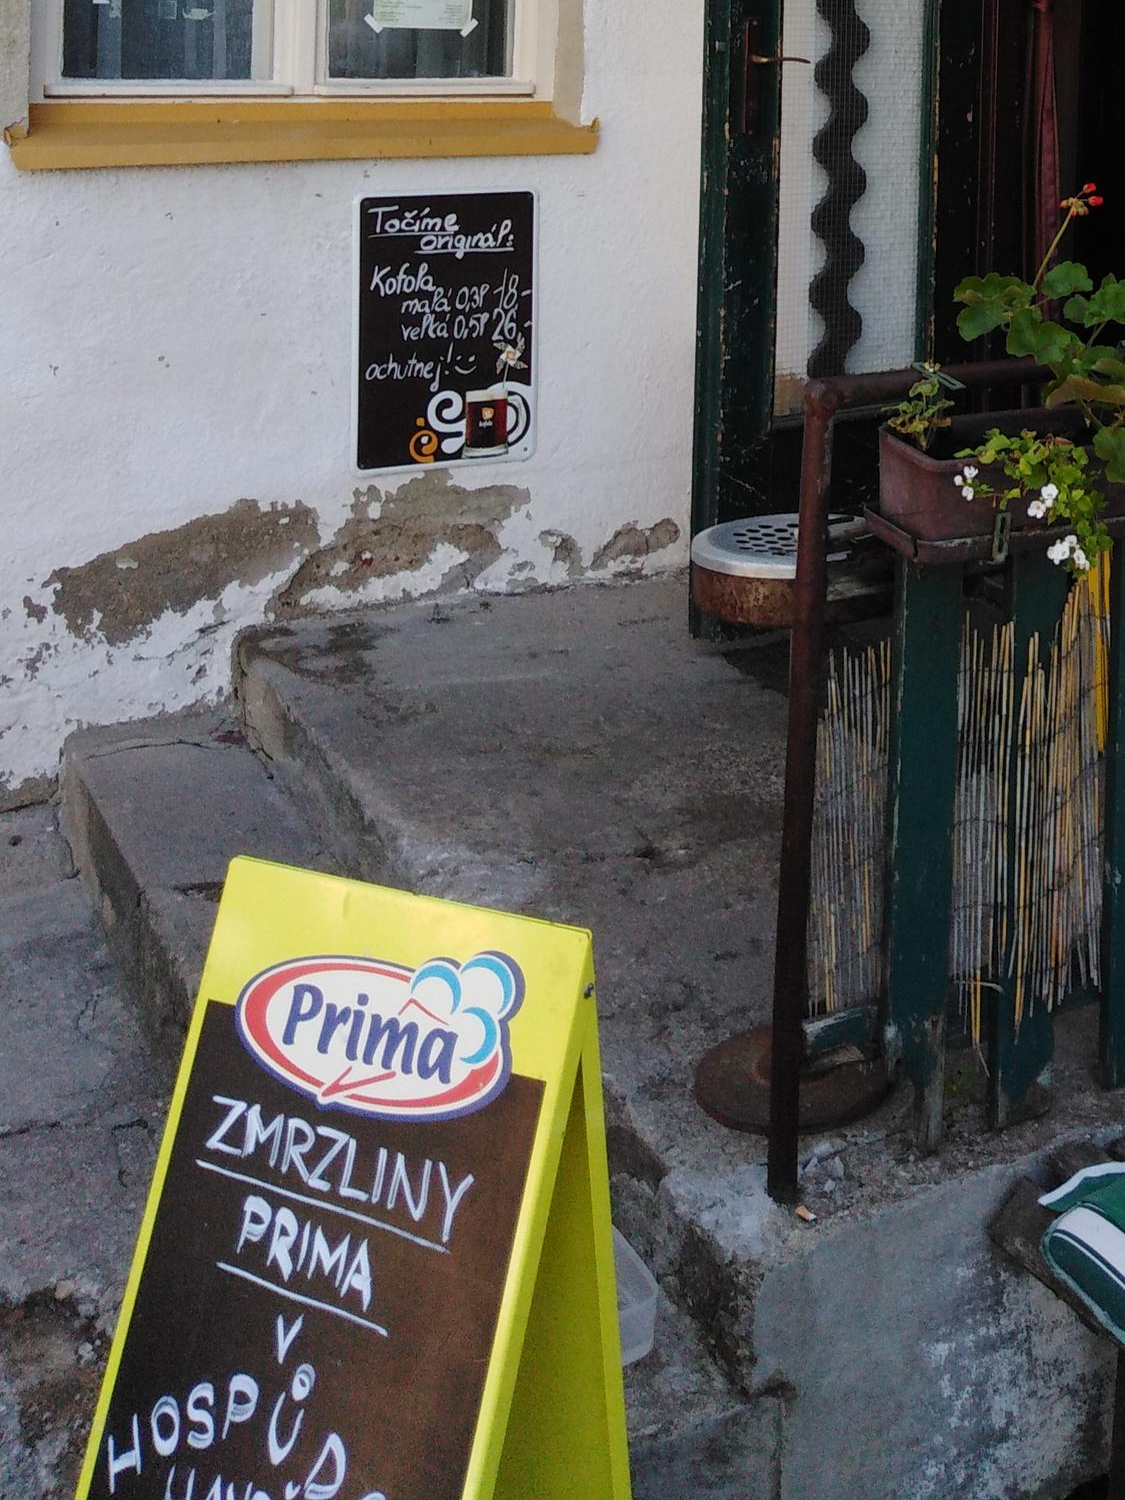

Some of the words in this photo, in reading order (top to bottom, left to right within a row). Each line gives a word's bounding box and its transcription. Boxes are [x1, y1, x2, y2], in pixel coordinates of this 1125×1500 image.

[368, 205, 460, 233] Točíme
[370, 262, 437, 297] Kofola
[401, 287, 452, 314] malá
[401, 311, 450, 341] velká
[282, 983, 458, 1085] Prima
[206, 1095, 475, 1243] ZMRZLINY
[235, 1195, 373, 1311] PRIMA
[277, 1313, 304, 1365] V
[108, 1363, 386, 1500] HOSPŮD
